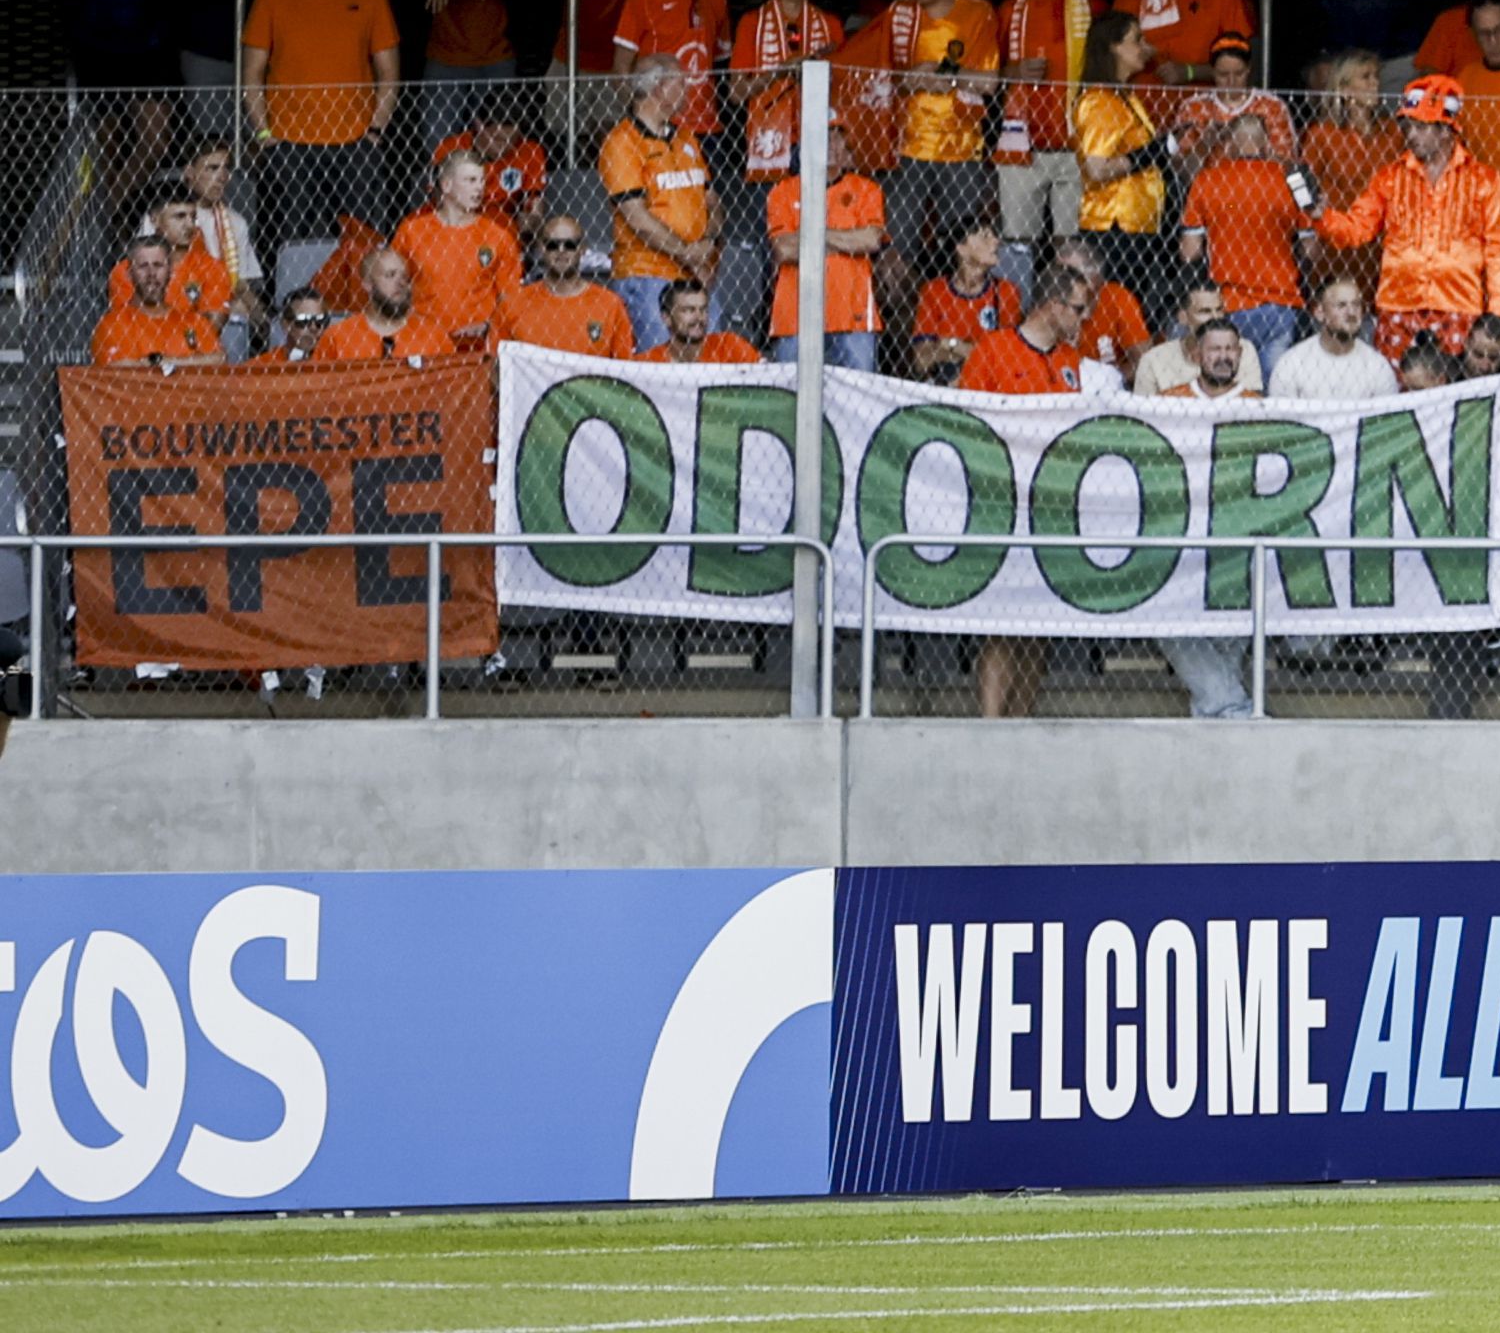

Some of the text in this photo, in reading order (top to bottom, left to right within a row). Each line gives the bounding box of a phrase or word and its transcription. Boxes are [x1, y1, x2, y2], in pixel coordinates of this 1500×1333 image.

[101, 410, 443, 460] BOUWMEESTER
[514, 374, 1496, 613] ODOORN
[107, 454, 453, 615] EPE
[894, 919, 1329, 1123] WELCOME
